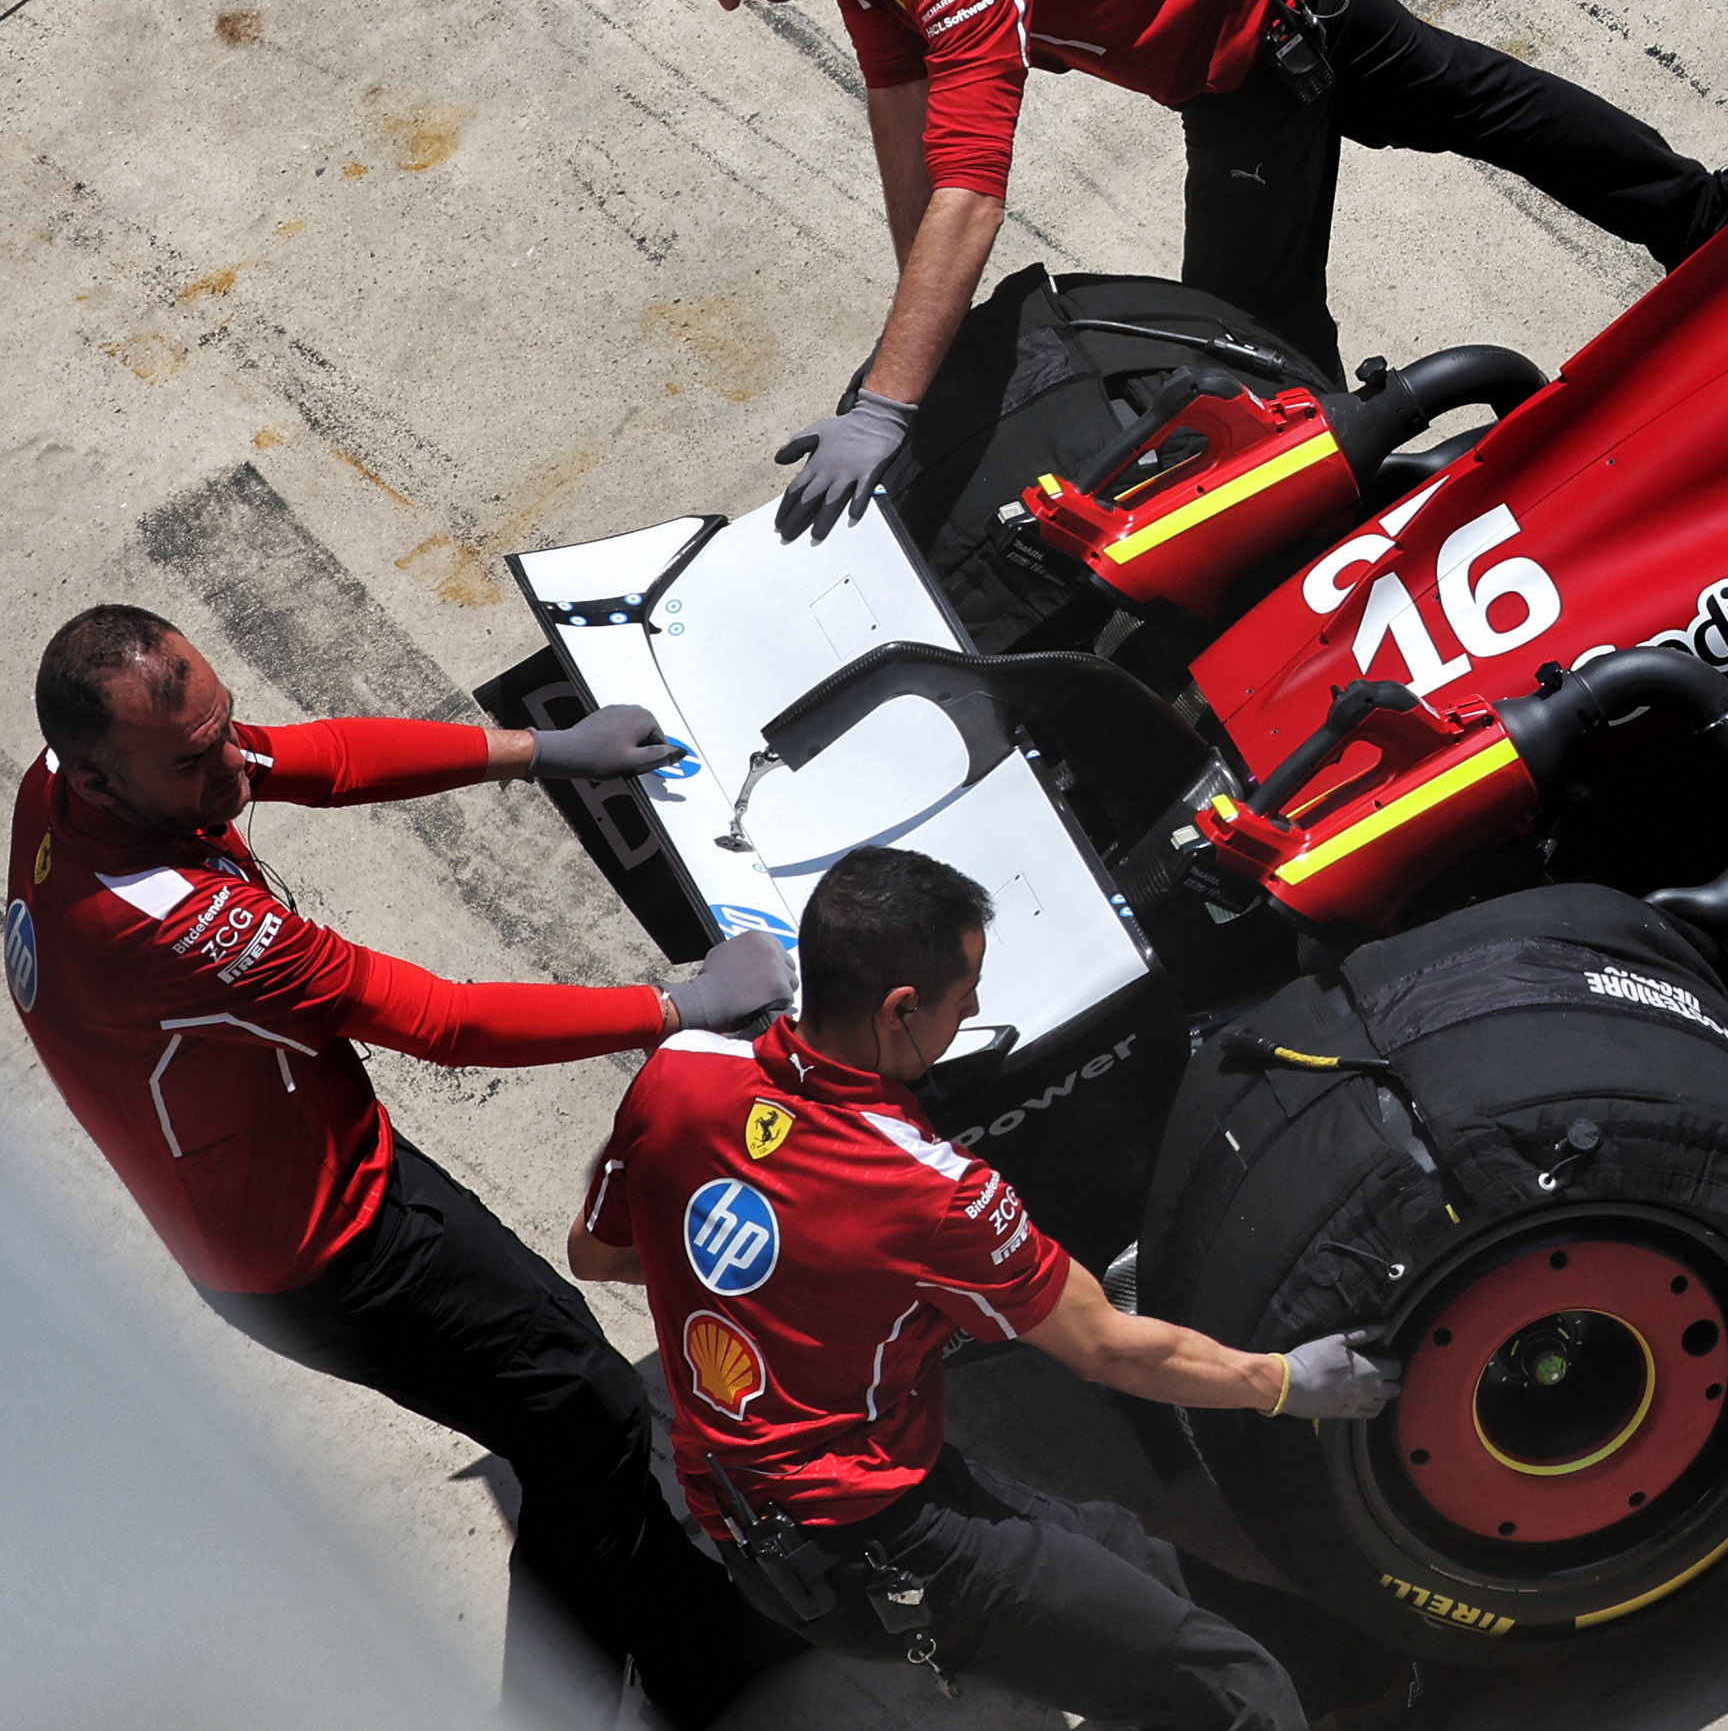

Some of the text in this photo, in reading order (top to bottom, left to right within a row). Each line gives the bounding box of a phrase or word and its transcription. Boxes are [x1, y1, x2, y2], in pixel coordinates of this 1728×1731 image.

[1351, 503, 1562, 696] 16
[171, 885, 232, 955] Bitdefender
[216, 912, 283, 985] PIRELLI
[685, 1179, 780, 1294] hp
